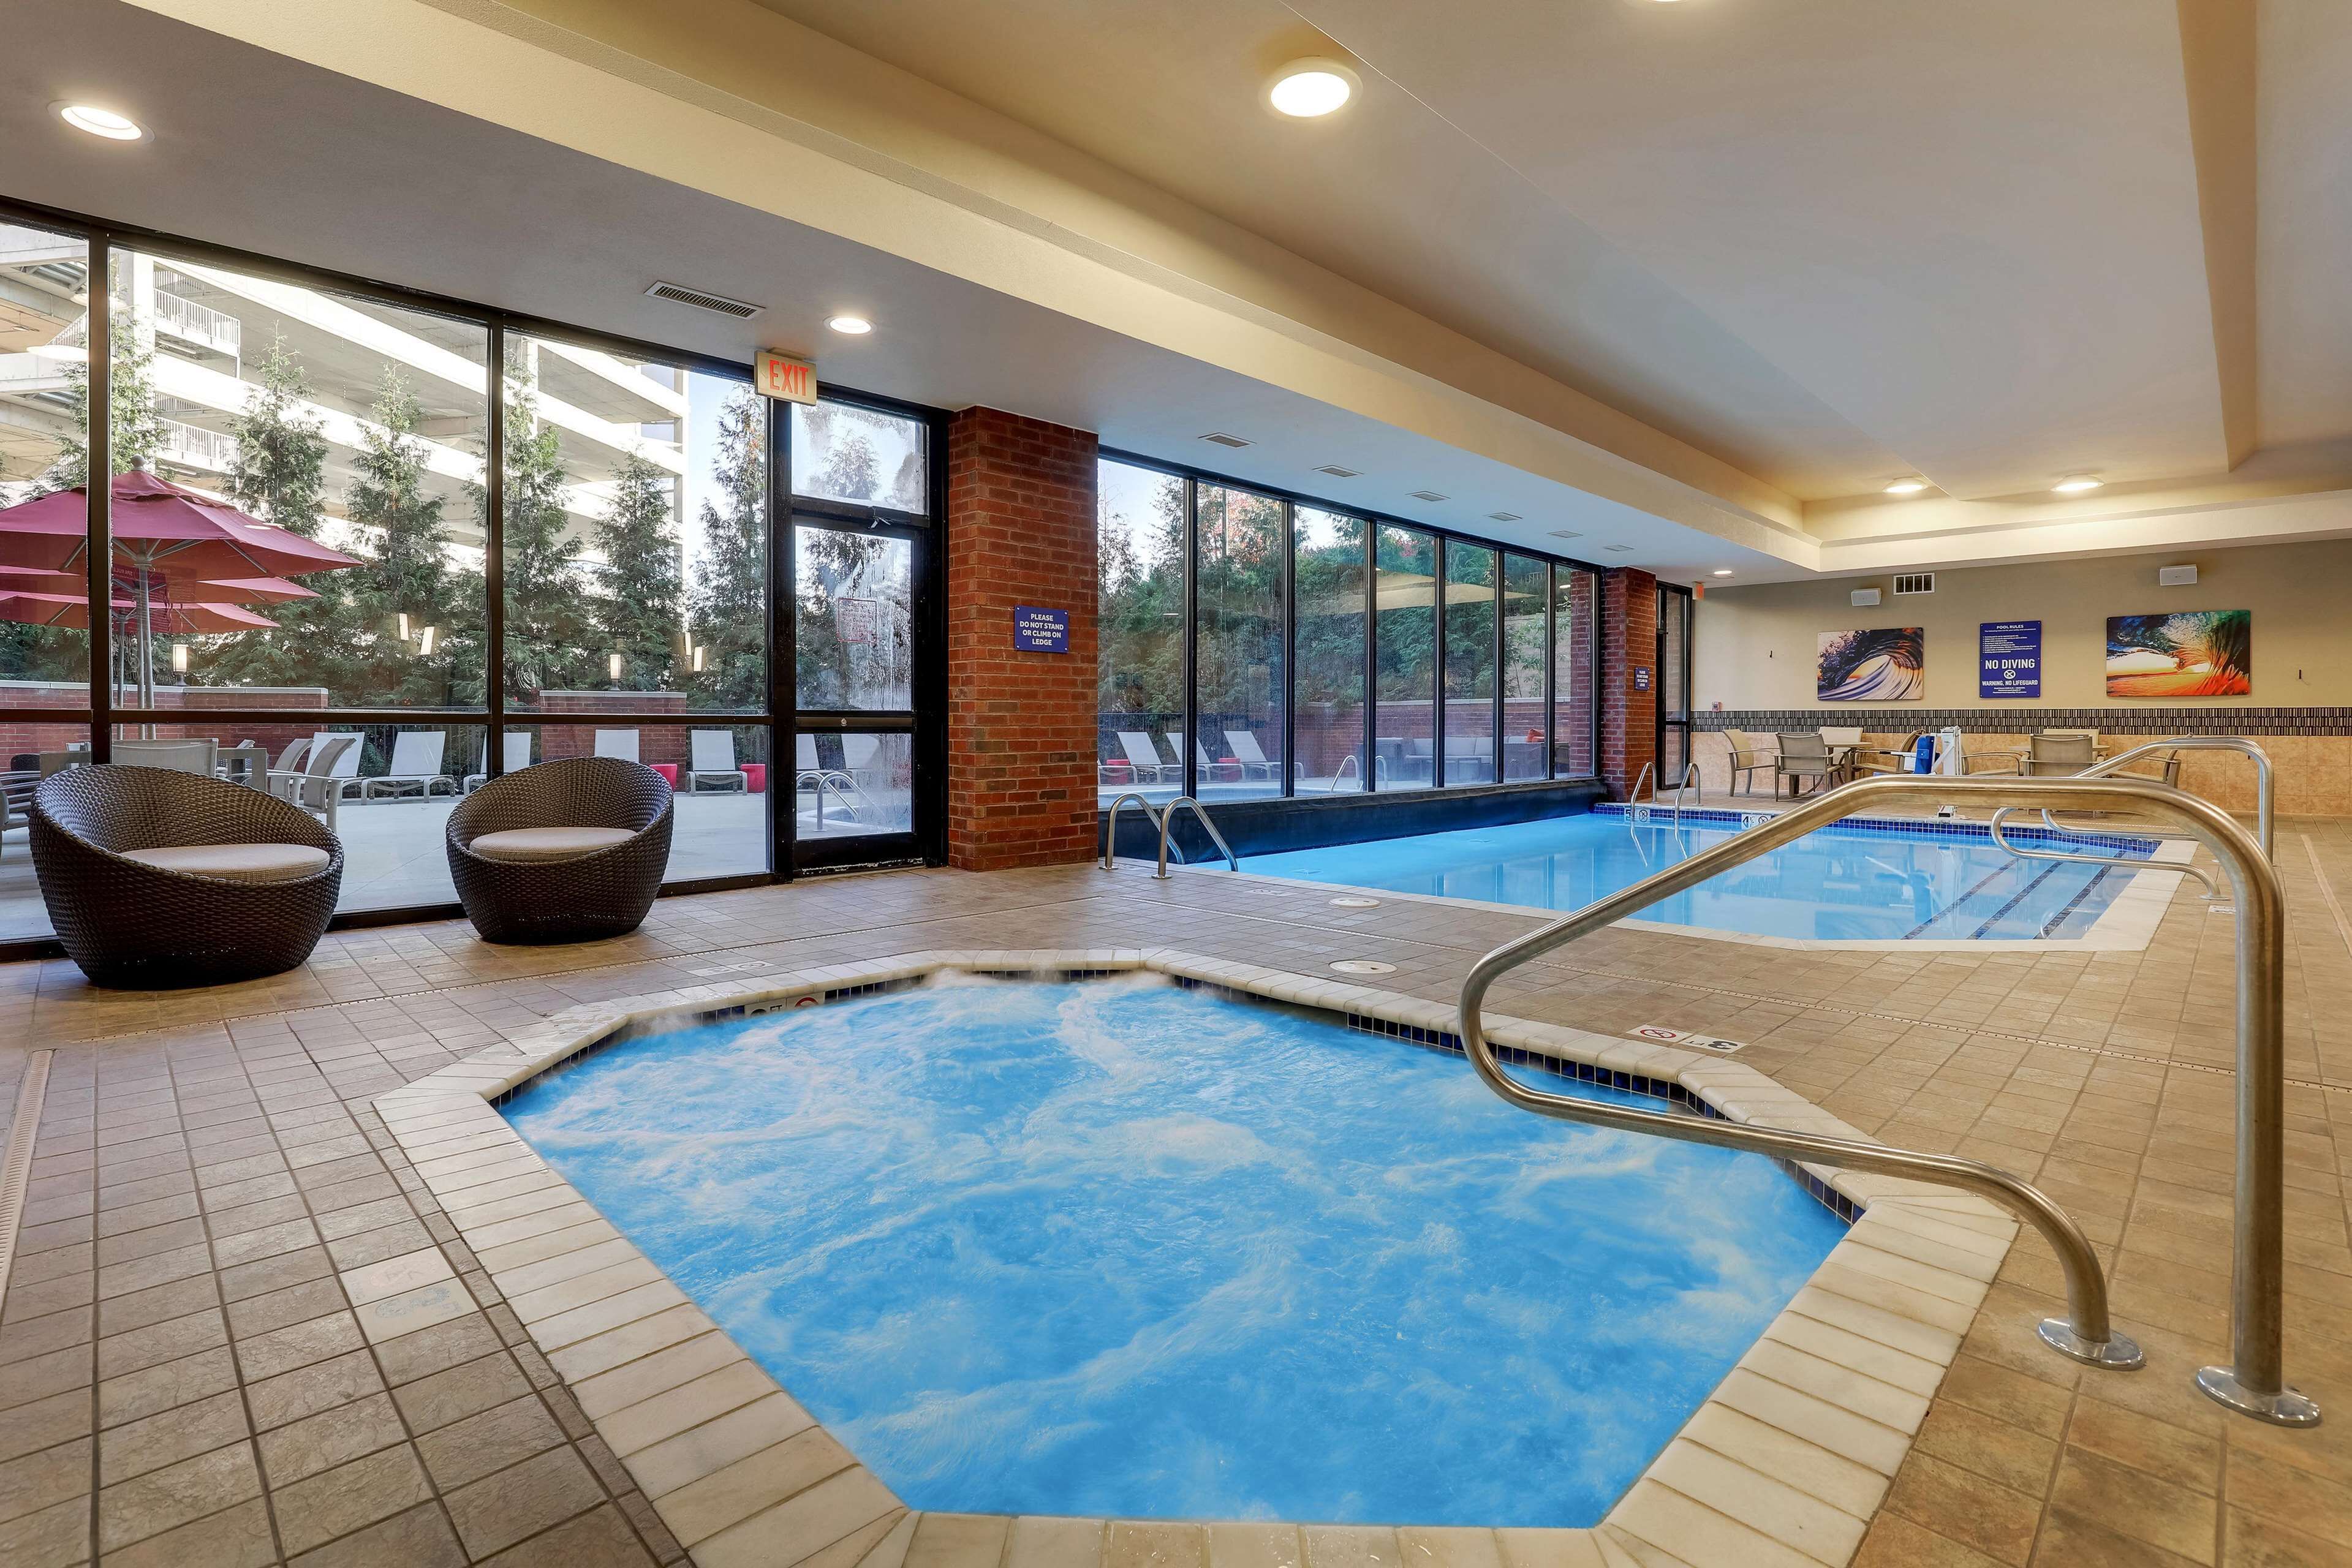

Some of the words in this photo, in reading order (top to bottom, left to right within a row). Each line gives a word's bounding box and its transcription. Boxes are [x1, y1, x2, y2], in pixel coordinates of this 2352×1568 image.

[769, 360, 808, 397] EXIT
[1985, 660, 1998, 669] NO
[2002, 658, 2035, 669] DIVING
[1707, 1041, 1738, 1050] 3
